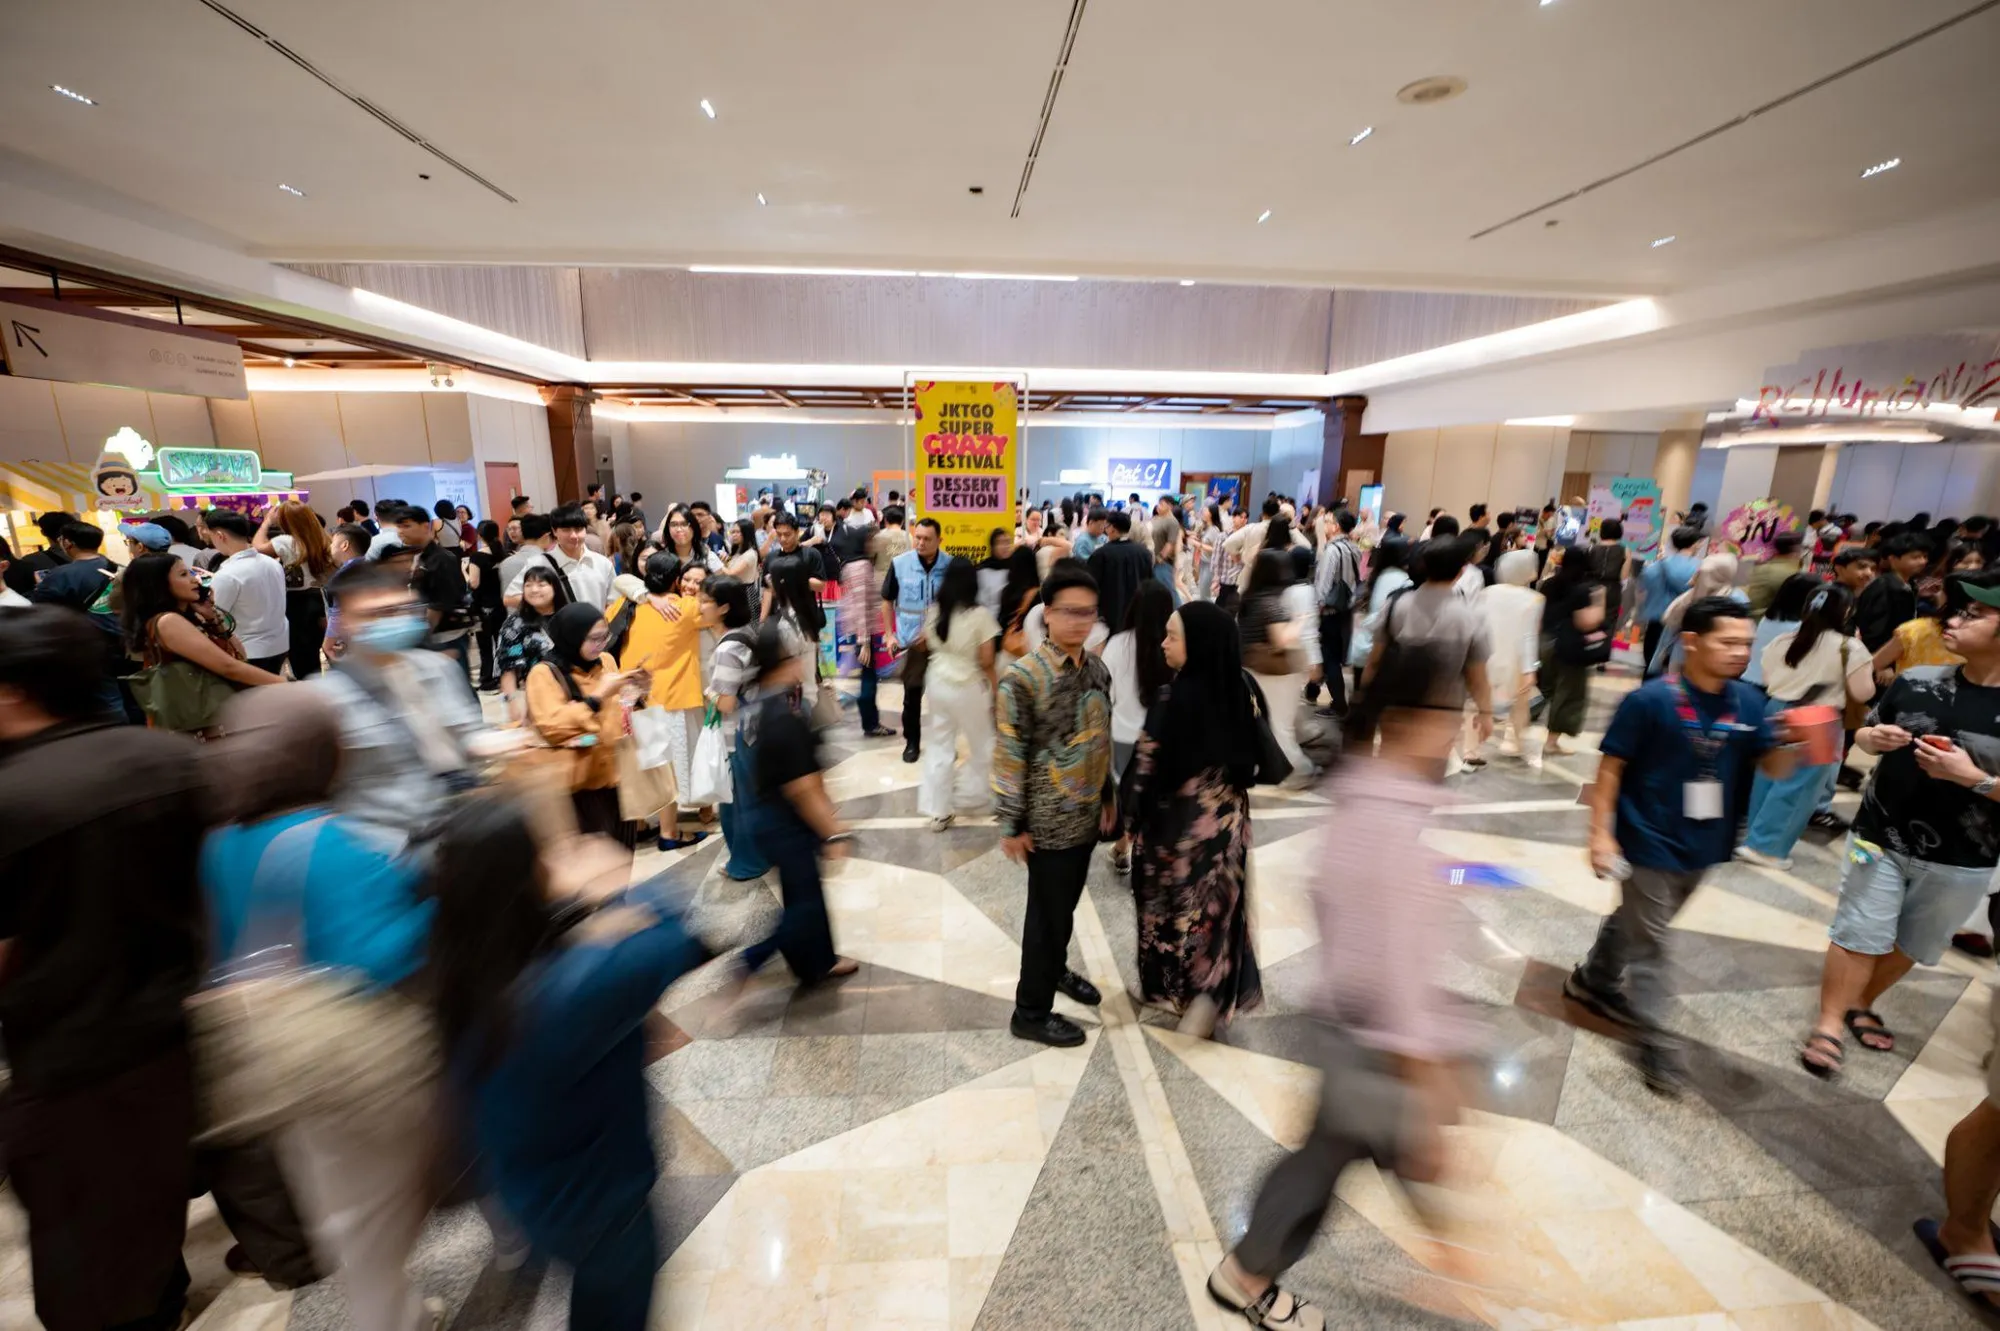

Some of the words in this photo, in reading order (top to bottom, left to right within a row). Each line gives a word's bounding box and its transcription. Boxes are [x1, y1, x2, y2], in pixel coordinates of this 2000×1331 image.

[938, 403, 994, 418] JKTGO
[938, 421, 994, 435] SUPER
[922, 433, 1009, 456] CRAZY
[928, 454, 1004, 469] FESTIVAL
[933, 477, 1000, 492] DESSERT
[933, 493, 999, 507] SECTION
